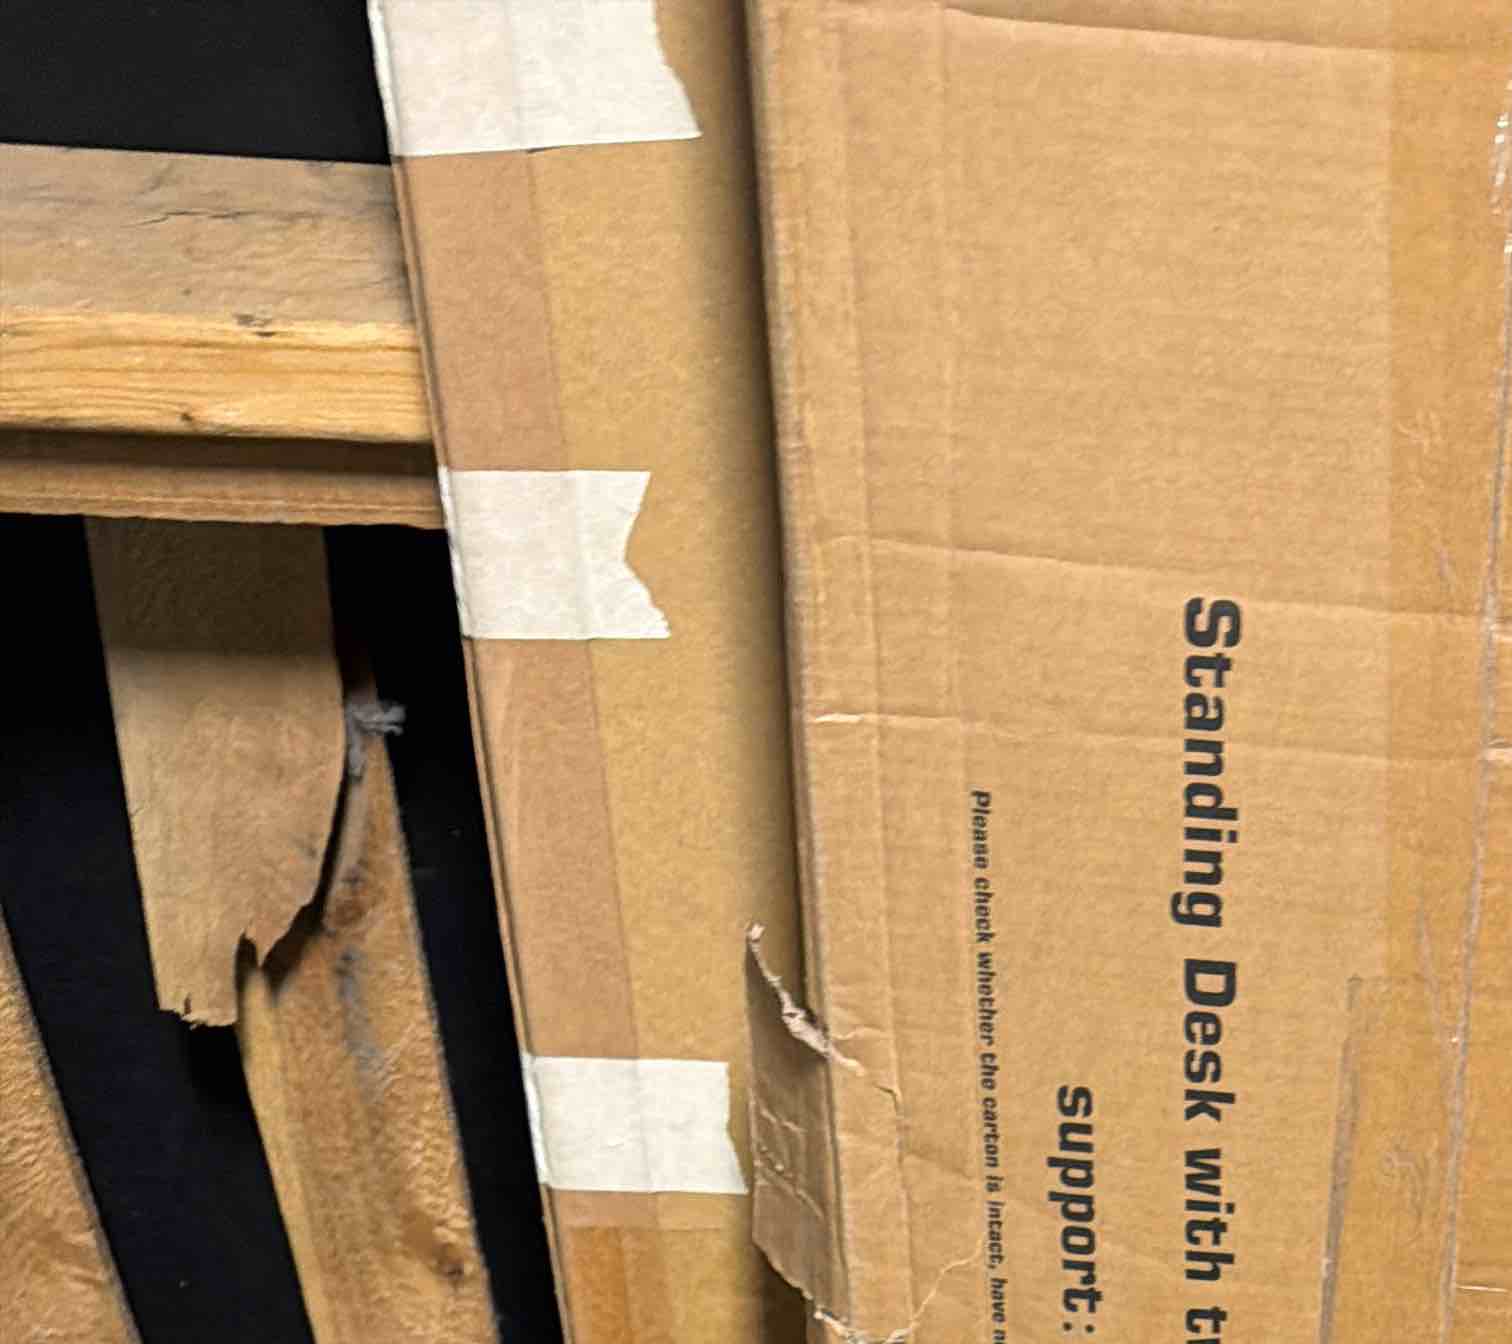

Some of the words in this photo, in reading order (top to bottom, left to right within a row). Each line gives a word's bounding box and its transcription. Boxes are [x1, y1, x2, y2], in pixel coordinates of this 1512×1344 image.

[1170, 597, 1242, 927] Standing
[967, 790, 993, 868] Please
[972, 877, 997, 943] check
[975, 952, 999, 1045] whether
[978, 1052, 1001, 1089] the
[1183, 958, 1238, 1122] Desk
[980, 1096, 1001, 1167] carton
[984, 1175, 1004, 1192] is
[1047, 1085, 1103, 1333] support:
[1184, 1148, 1235, 1281] with
[983, 1200, 1007, 1269] intact,
[989, 1278, 1009, 1323] have
